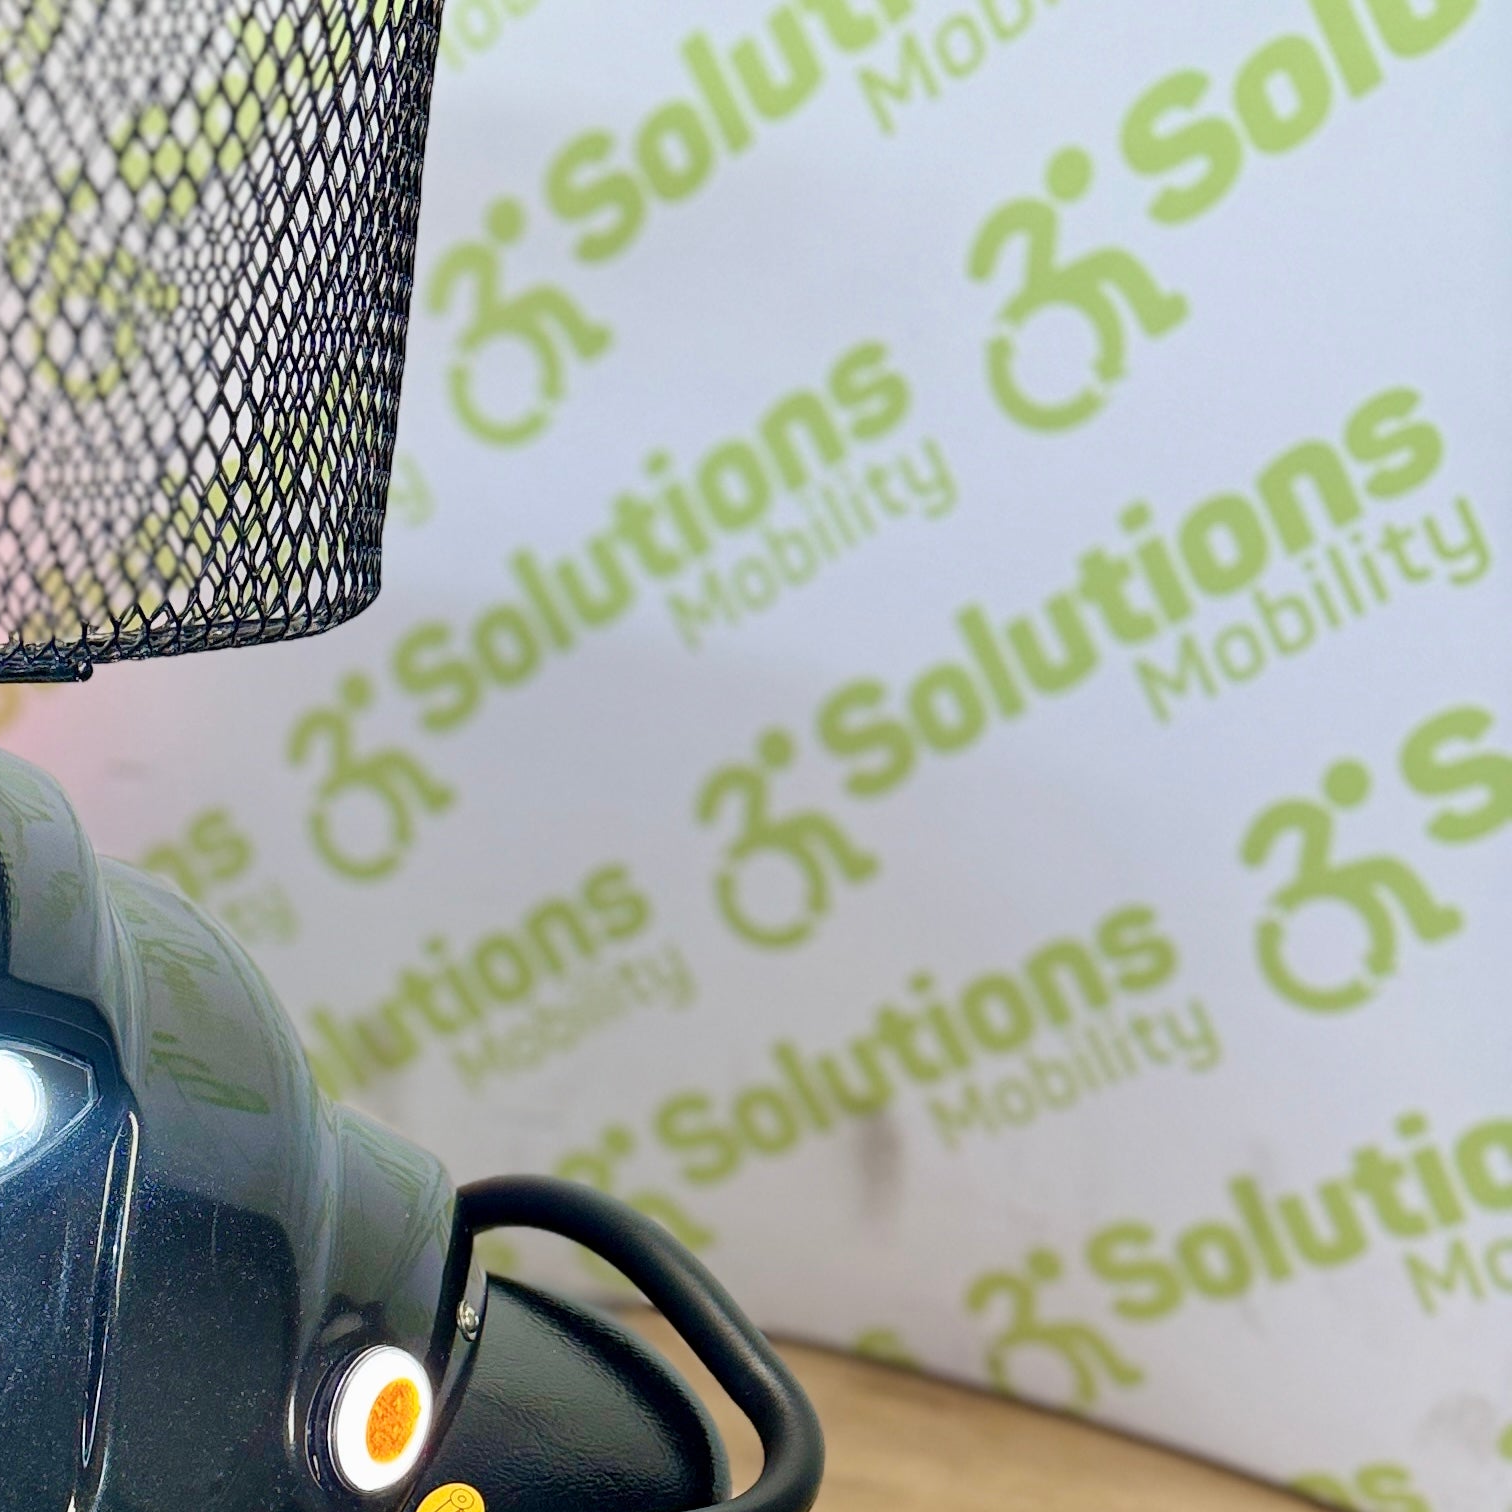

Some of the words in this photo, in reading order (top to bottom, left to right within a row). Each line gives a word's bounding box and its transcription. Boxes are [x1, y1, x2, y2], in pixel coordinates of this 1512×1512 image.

[392, 338, 912, 733] Solutions
[815, 385, 1445, 800] Solutions
[1131, 495, 1491, 725] Mobility
[308, 862, 649, 1103] lutions
[654, 904, 1180, 1187] Solutions
